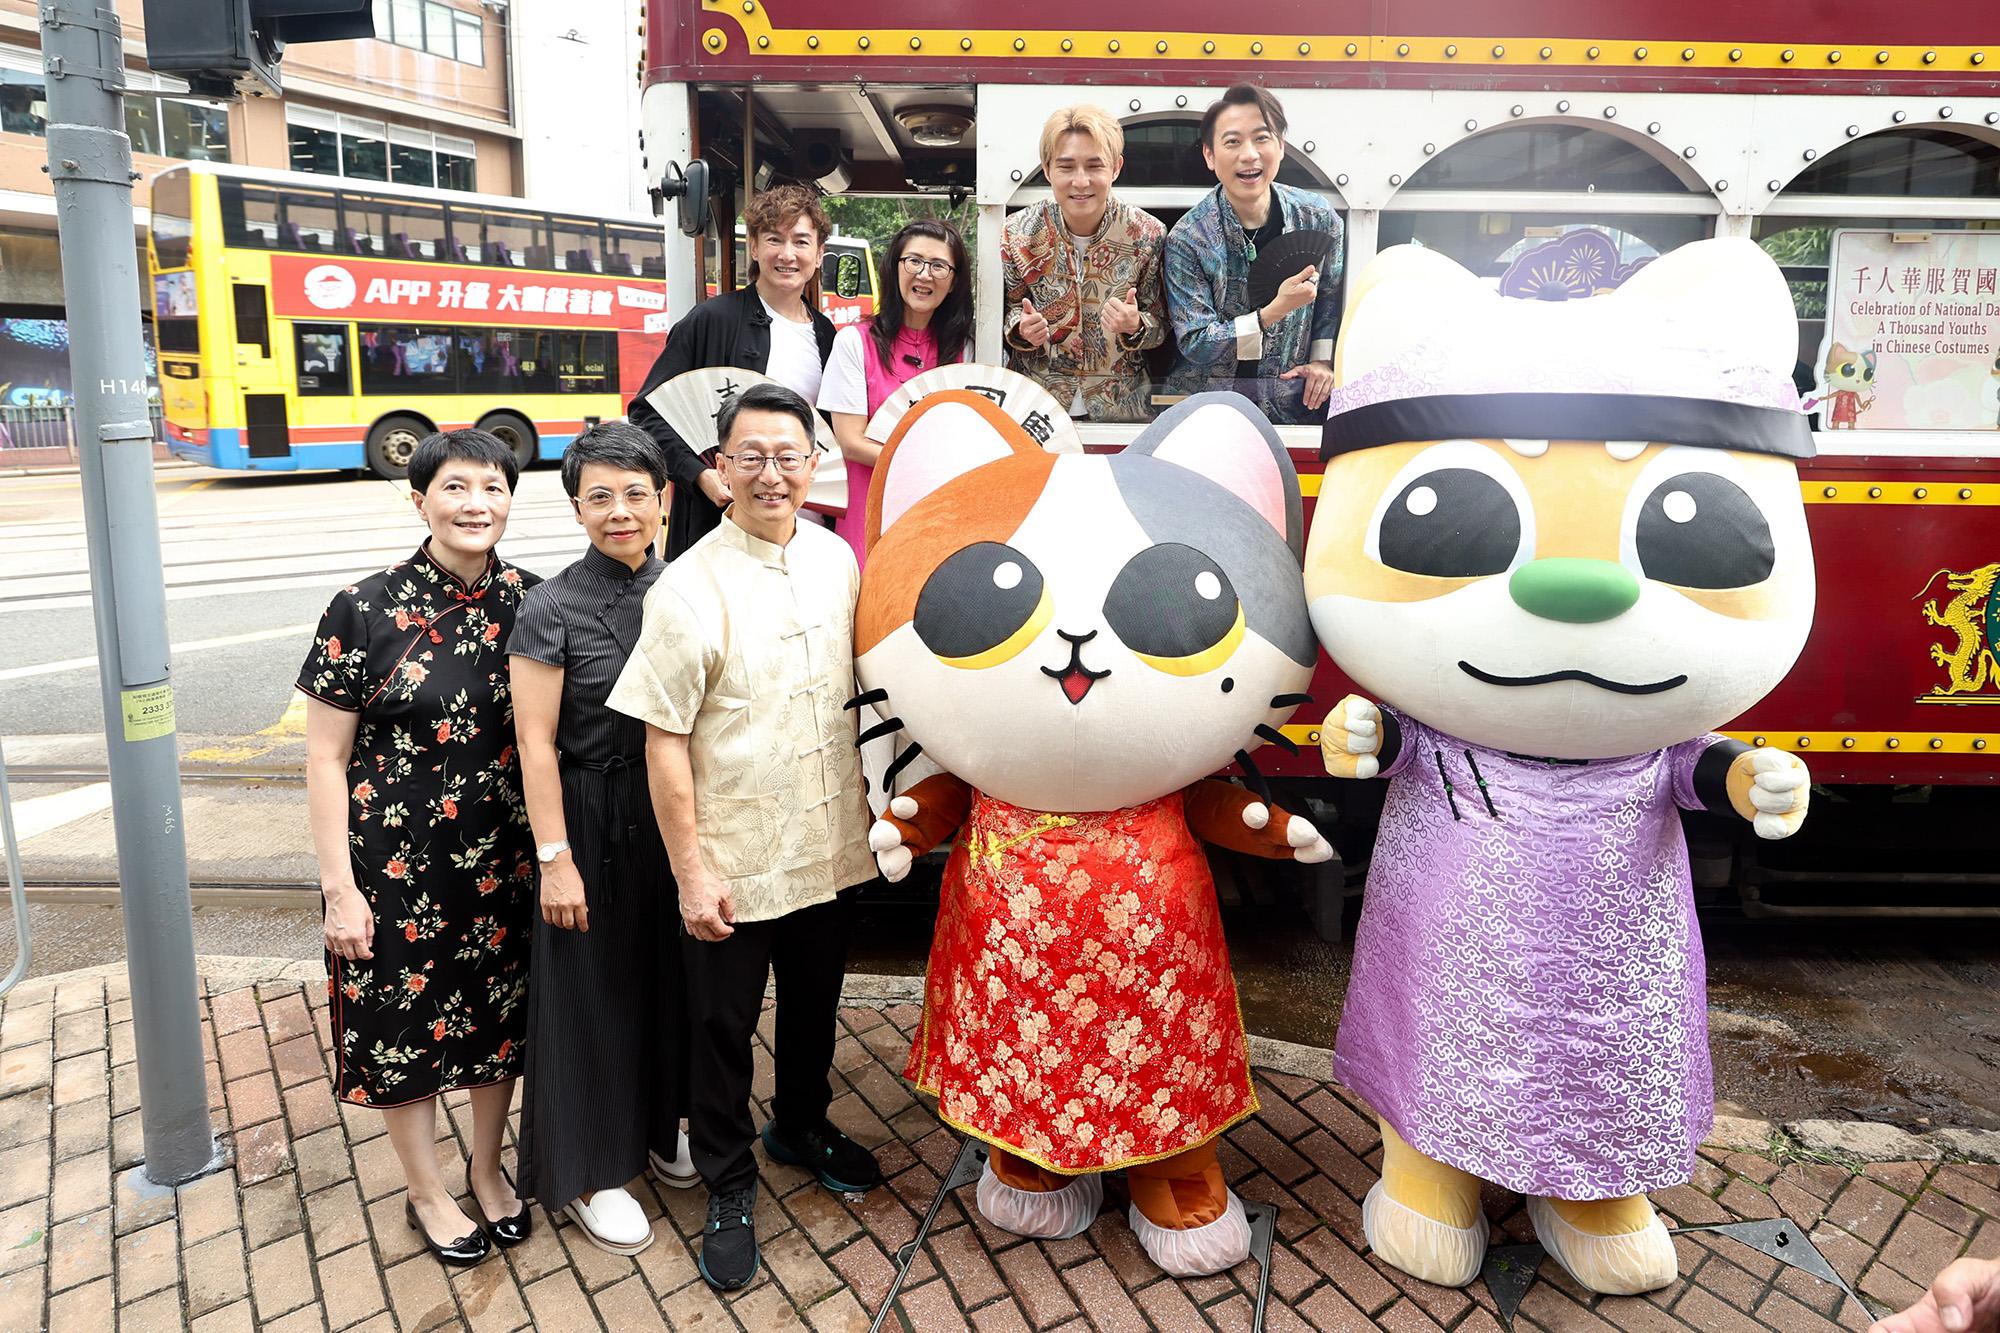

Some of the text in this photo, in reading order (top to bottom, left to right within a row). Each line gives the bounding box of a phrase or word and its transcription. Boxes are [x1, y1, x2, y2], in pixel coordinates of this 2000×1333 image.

[1851, 266, 1998, 295] 千人華服賀國
[363, 278, 432, 305] APP
[1850, 301, 1916, 316] Celebration
[1919, 301, 1932, 316] of
[1935, 302, 1982, 316] National
[1877, 320, 1988, 335] A Thousand Youths
[1872, 339, 1990, 354] in Chinese Costumes
